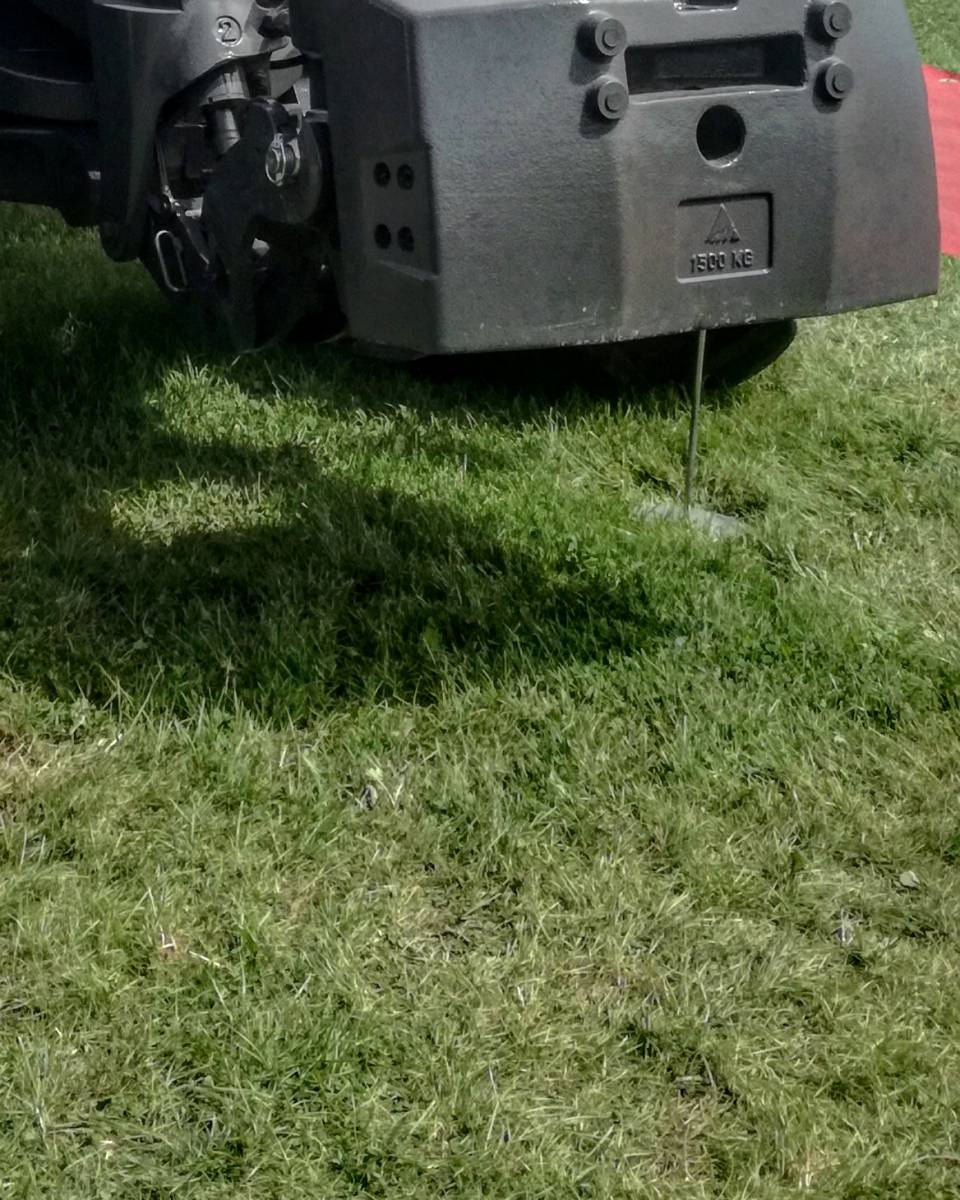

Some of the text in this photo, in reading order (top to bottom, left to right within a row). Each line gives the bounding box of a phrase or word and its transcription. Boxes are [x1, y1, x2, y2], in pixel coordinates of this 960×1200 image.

[218, 20, 238, 43] 2
[690, 248, 754, 273] 1500 KG
